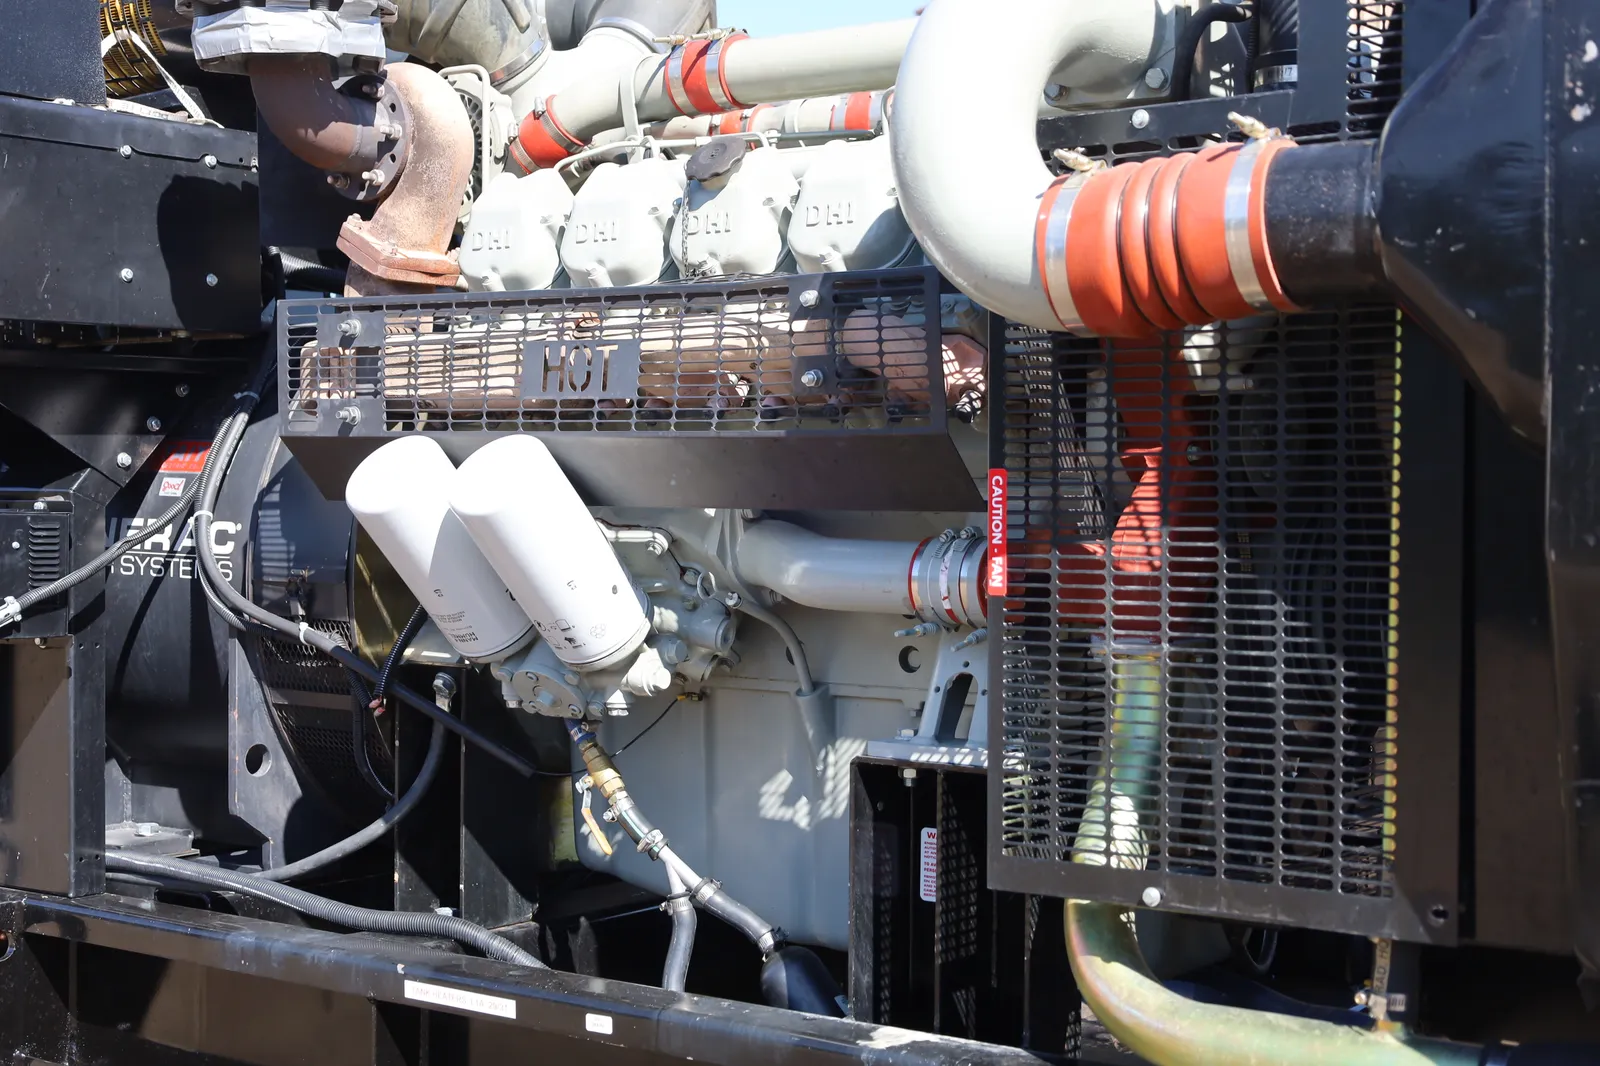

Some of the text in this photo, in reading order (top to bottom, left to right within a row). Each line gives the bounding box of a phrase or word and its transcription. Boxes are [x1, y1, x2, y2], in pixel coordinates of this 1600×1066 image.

[541, 344, 619, 392] HOT
[991, 475, 1003, 544] CAUTION
[120, 555, 233, 581] SYSTES
[990, 556, 1003, 588] FAN
